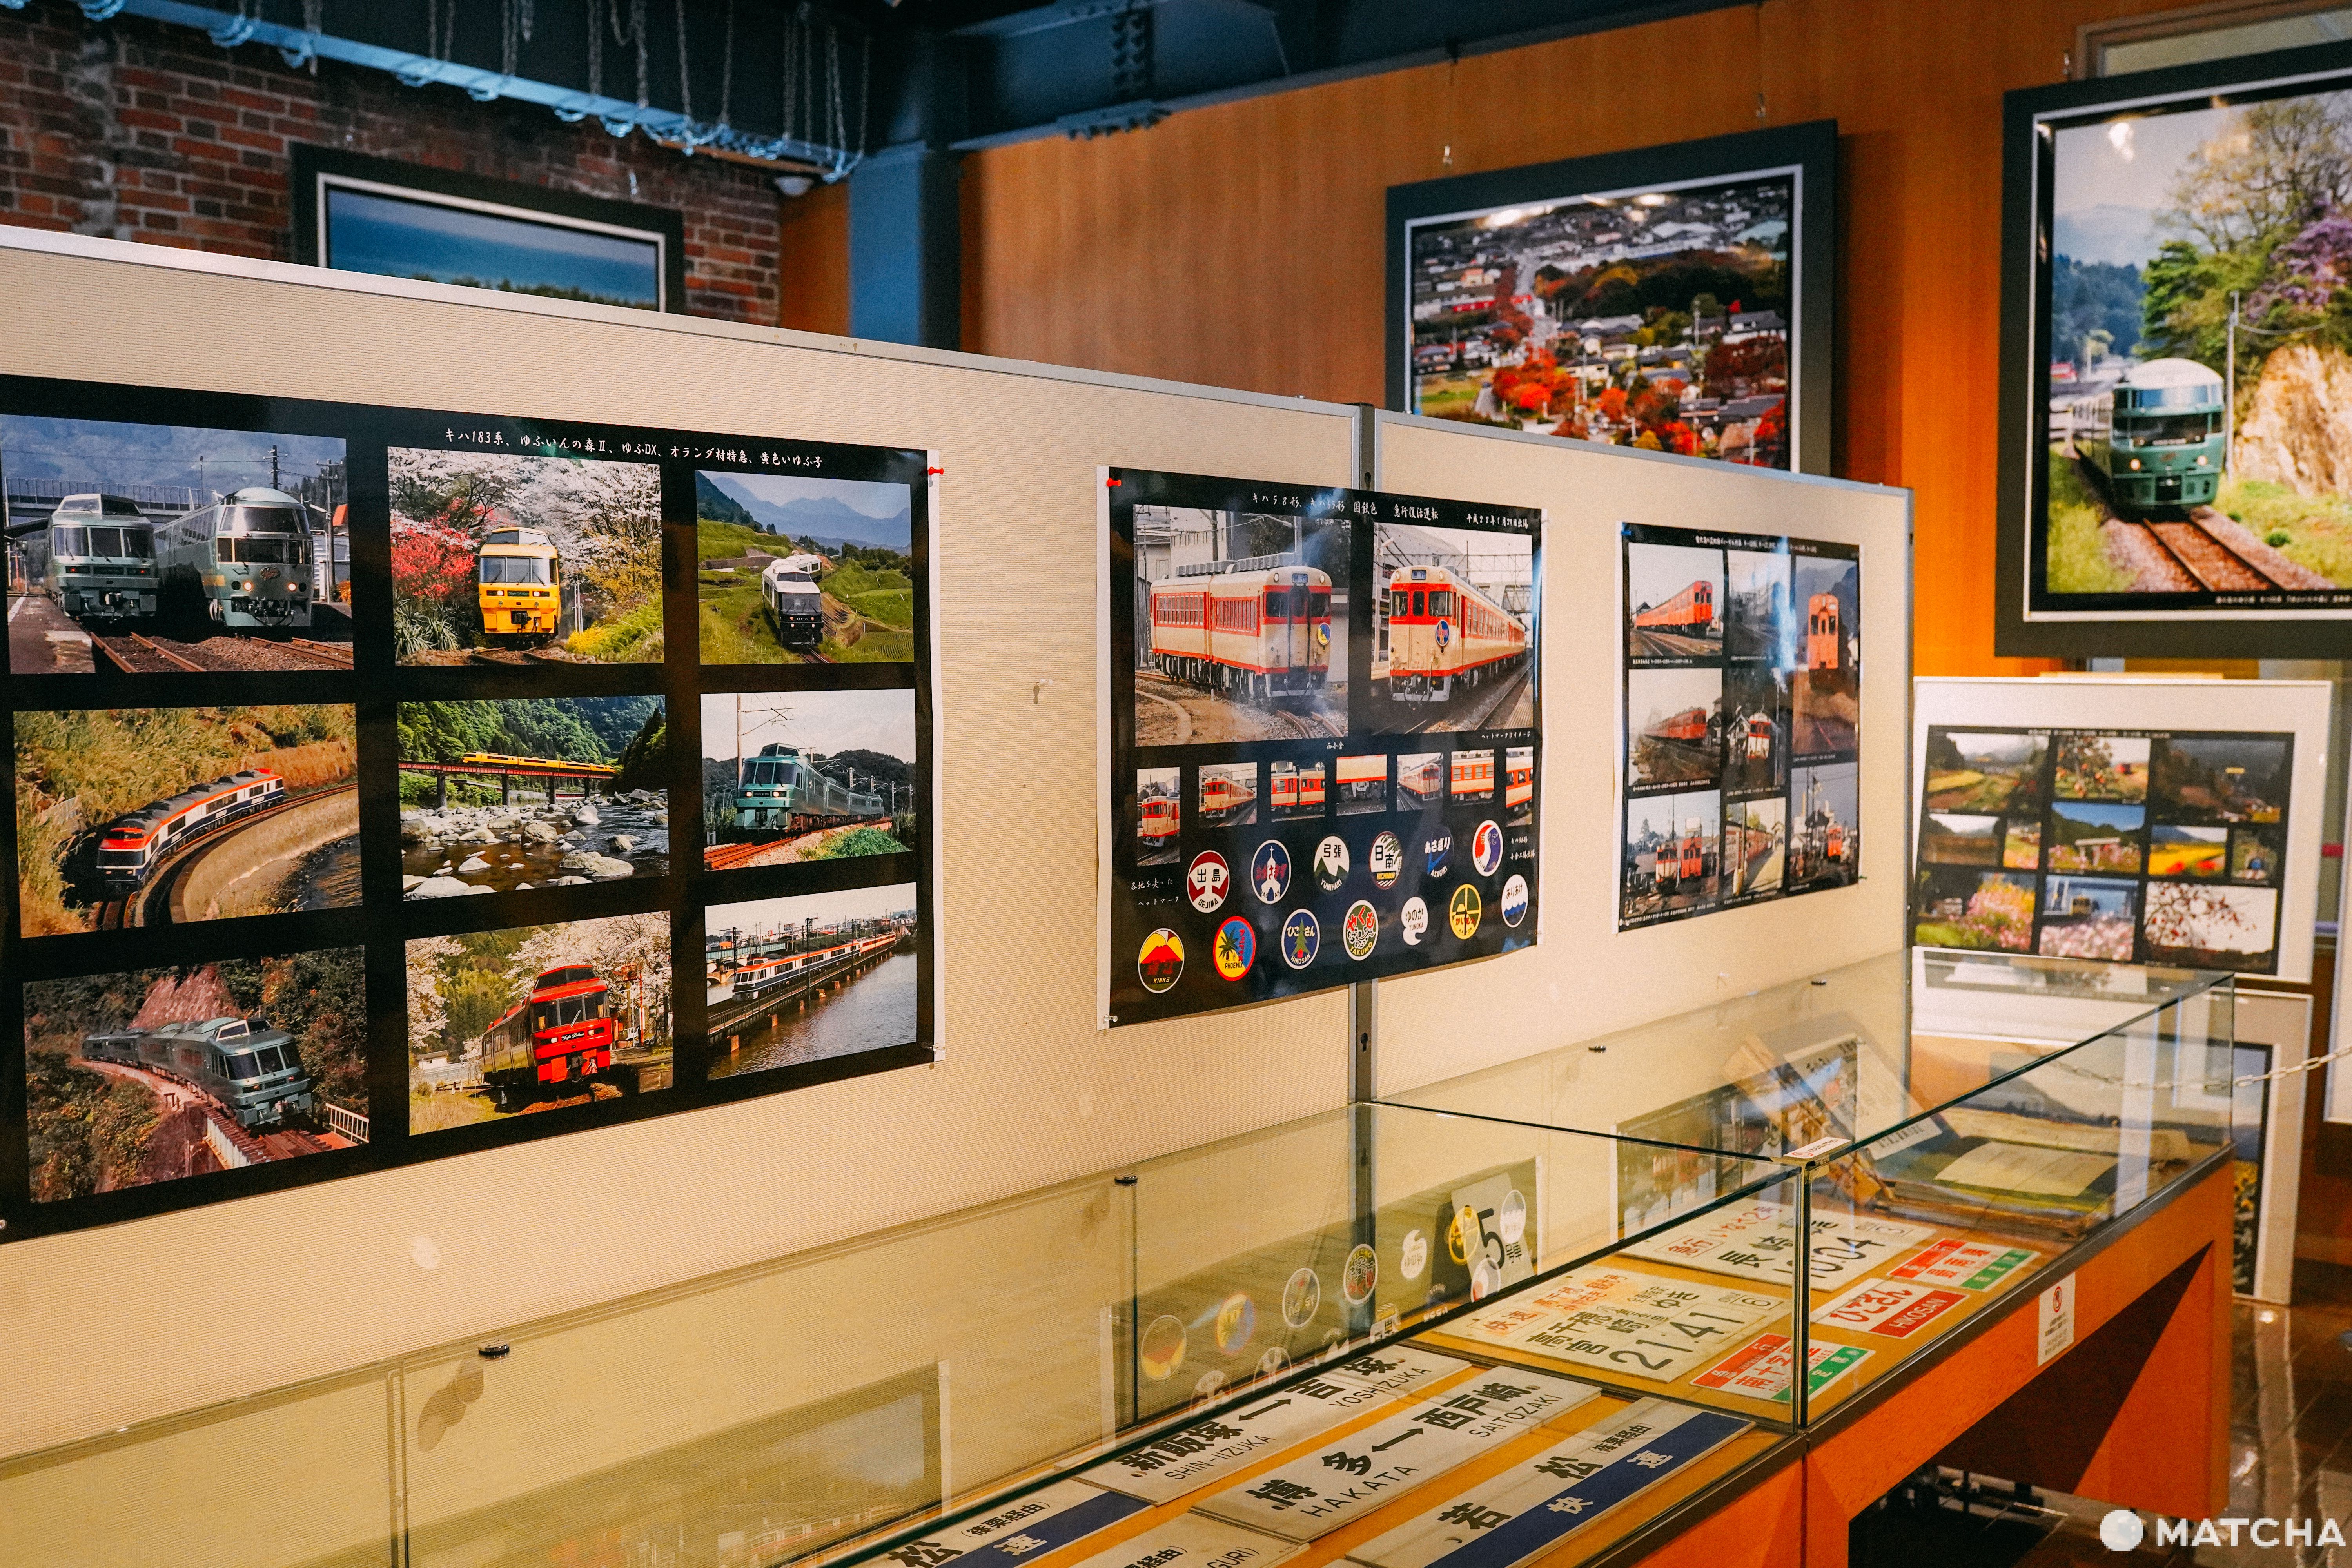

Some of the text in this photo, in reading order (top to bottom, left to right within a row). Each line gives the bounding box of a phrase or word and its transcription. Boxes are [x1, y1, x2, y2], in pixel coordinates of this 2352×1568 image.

[1394, 503, 1439, 521] 急行復活運転
[1323, 844, 1341, 858] 弓張
[1425, 837, 1451, 854] あさぎり
[1375, 845, 1394, 869] 日南
[1197, 869, 1220, 883] 出島
[1430, 865, 1448, 878] ASAGIRI
[1320, 878, 1342, 891] YUMIHARI
[1198, 898, 1219, 909] DEJIMA
[1347, 906, 1375, 932] やくも
[1405, 907, 1423, 923] ゆのか
[1287, 926, 1315, 938] ひこさん
[1409, 922, 1424, 931] YUNOKA
[1290, 953, 1311, 965] HIKOSAN
[1350, 941, 1373, 956] YAKUMO
[1669, 1239, 1712, 1255] 急行
[1717, 1236, 1793, 1267] 長崎
[1741, 1297, 1771, 1307] 6
[1483, 1310, 1537, 1330] 快速
[1526, 1311, 1612, 1347] 高千穂
[1650, 1291, 1700, 1308] ゆき
[1888, 1298, 1947, 1328] HIKOSAN
[1566, 1319, 1649, 1354] 宮崎
[1609, 1312, 1744, 1370] 21:41
[1111, 1356, 1399, 1470] 新飯塚 吉塚
[1164, 1367, 1432, 1480] SHIN-IIZUKA YOSHIZUKA
[1247, 1382, 1532, 1508] 博多 西戸崎
[1300, 1394, 1563, 1517] HAKATA SAITOZAKI
[1439, 1456, 1603, 1531] 若松
[961, 1501, 1050, 1538] (篠栗経由)
[993, 1534, 1048, 1556] 速
[1123, 1546, 1188, 1568] 経由)
